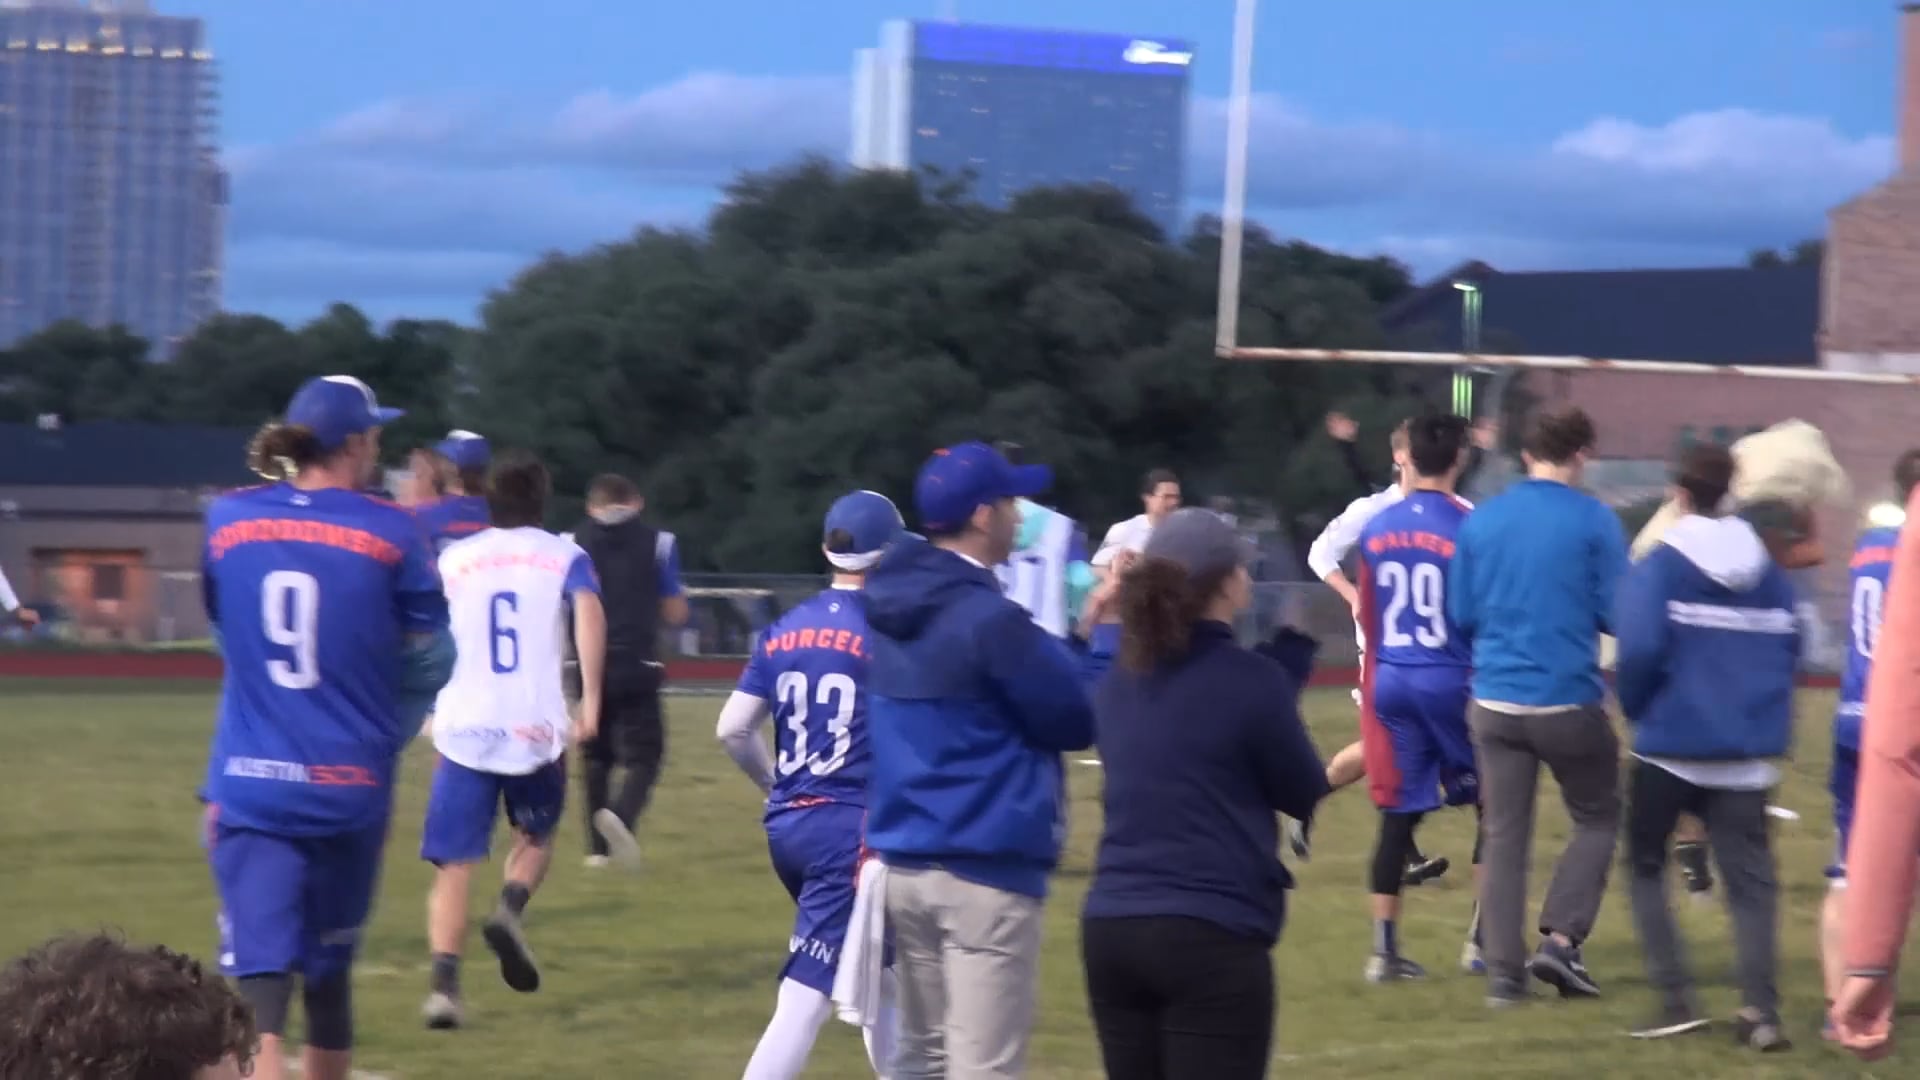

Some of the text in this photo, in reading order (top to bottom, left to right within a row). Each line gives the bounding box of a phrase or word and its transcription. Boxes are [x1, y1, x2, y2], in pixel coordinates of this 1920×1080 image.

[261, 570, 321, 690] 9
[489, 590, 519, 675] 6
[765, 627, 874, 662] PURCEL
[1376, 560, 1448, 648] 29
[775, 670, 857, 777] 33
